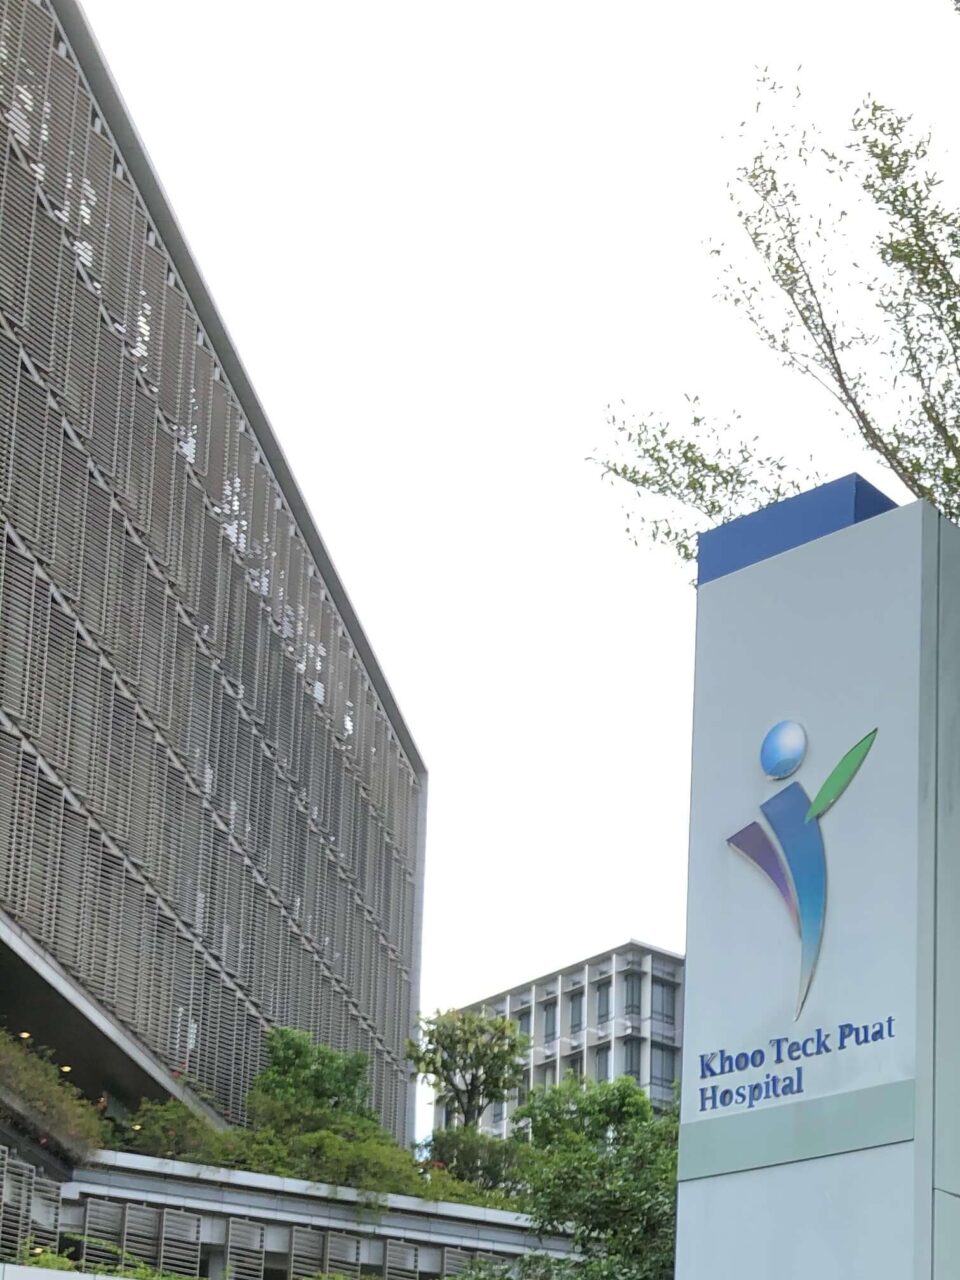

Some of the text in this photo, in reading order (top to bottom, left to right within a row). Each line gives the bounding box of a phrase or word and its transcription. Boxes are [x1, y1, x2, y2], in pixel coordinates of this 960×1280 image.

[699, 1015, 895, 1079] Khoo Teck Puat
[698, 1066, 804, 1112] Hospital
